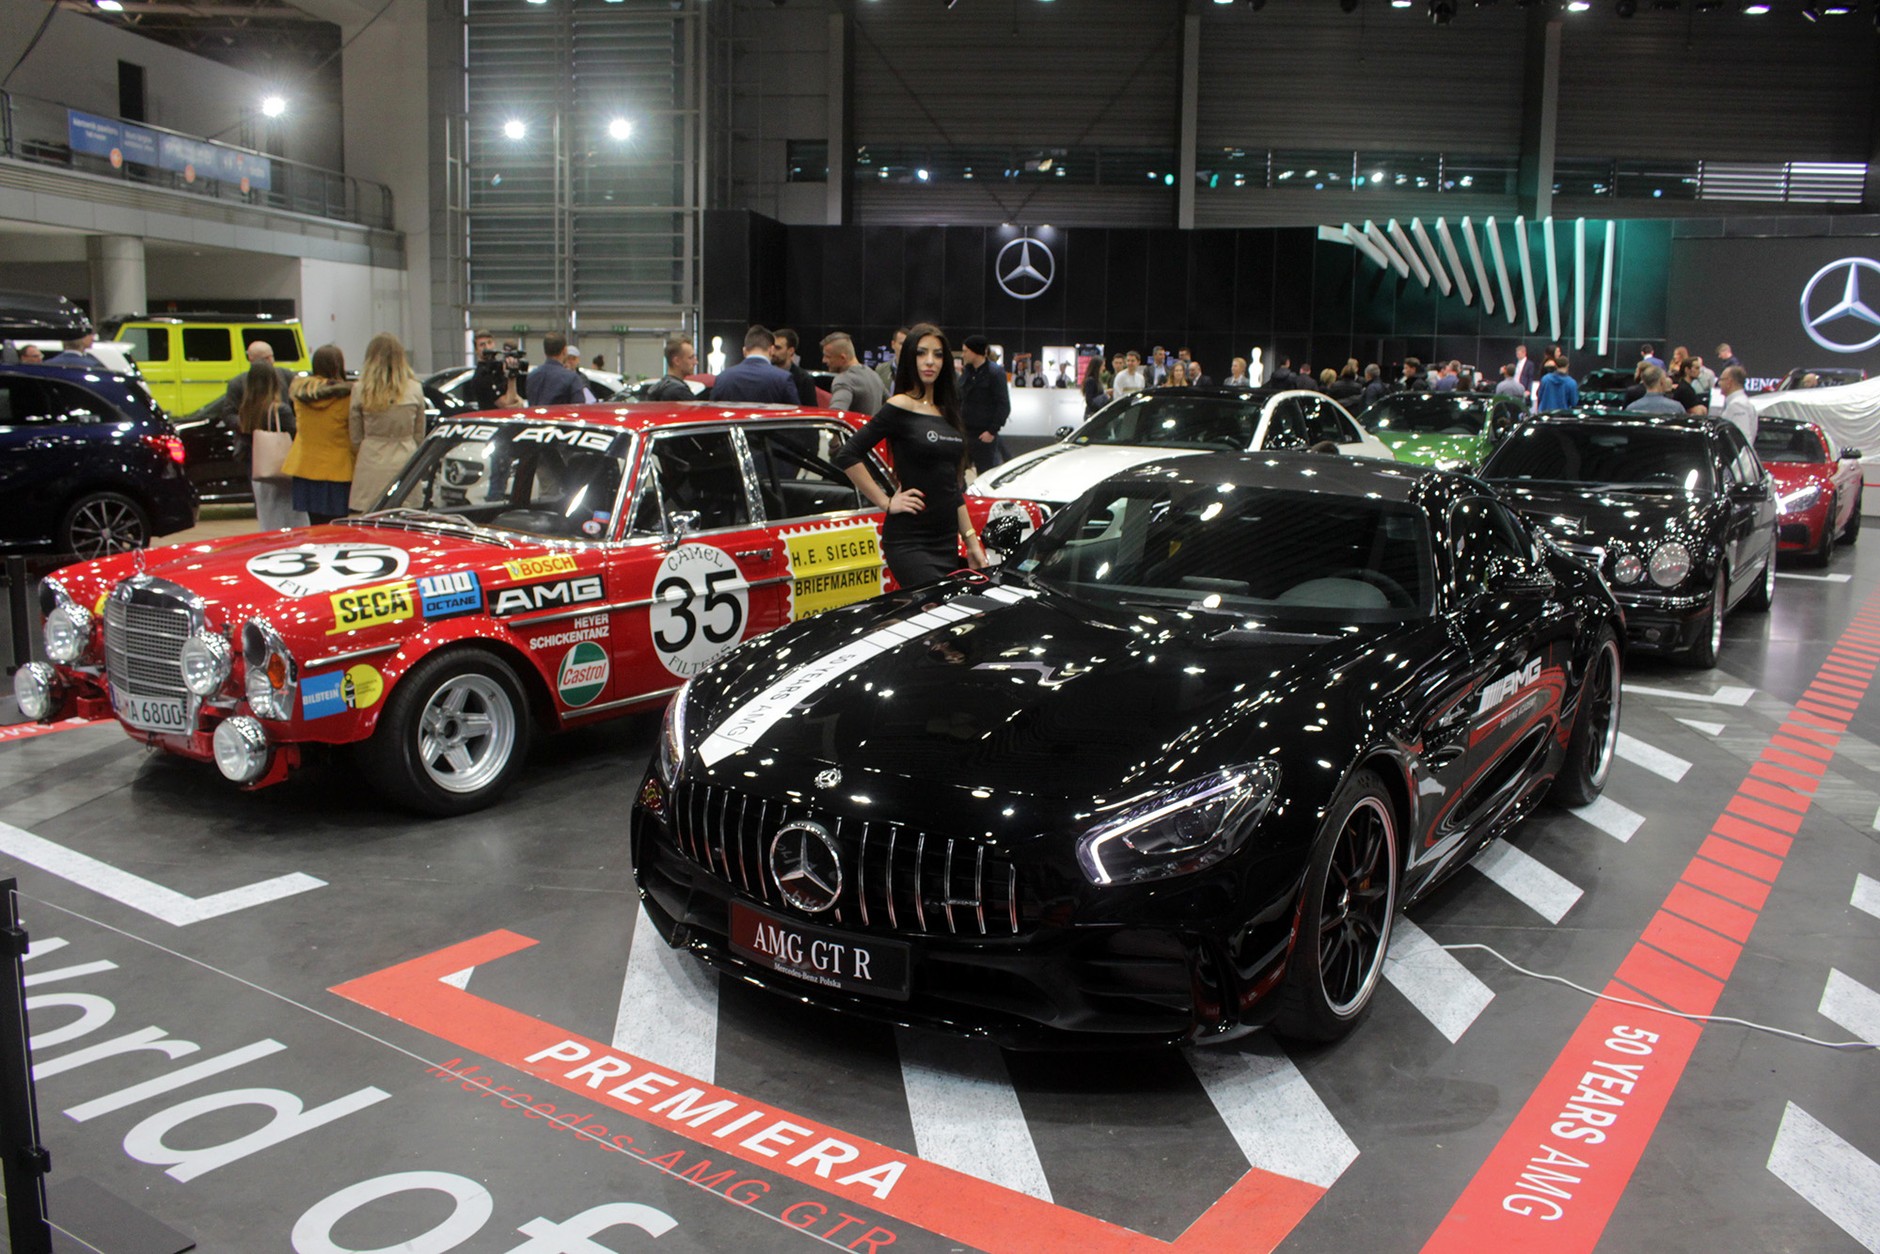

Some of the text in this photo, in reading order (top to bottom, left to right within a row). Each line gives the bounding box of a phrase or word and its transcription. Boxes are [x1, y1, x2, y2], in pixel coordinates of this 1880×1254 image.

[429, 424, 499, 441] AMG
[512, 426, 615, 452] AMG
[251, 547, 399, 580] 35
[521, 556, 575, 577] BOSCH
[667, 547, 724, 572] CAMEL
[792, 539, 876, 567] H.E. SIEGER
[419, 571, 475, 597] 100
[495, 575, 603, 615] AMG
[794, 568, 878, 597] BRIEFMARKEN
[339, 588, 409, 624] SECA
[426, 595, 476, 612] OCTANE
[653, 569, 743, 654] 35
[574, 614, 609, 629] HEYER
[529, 625, 610, 650] SCHICKENTANZ
[562, 662, 608, 687] Castrol
[769, 666, 835, 701] YEARS
[302, 687, 340, 706] BILSTEIN
[726, 704, 773, 736] AMG
[753, 922, 873, 981] AMG GT R
[774, 962, 842, 989] Mercedes-Benz Polska
[524, 1040, 907, 1200] PREMIERA
[1502, 1025, 1660, 1221] 50 YEARS AMG
[425, 1057, 898, 1254] Mercedes-AMG GTR
